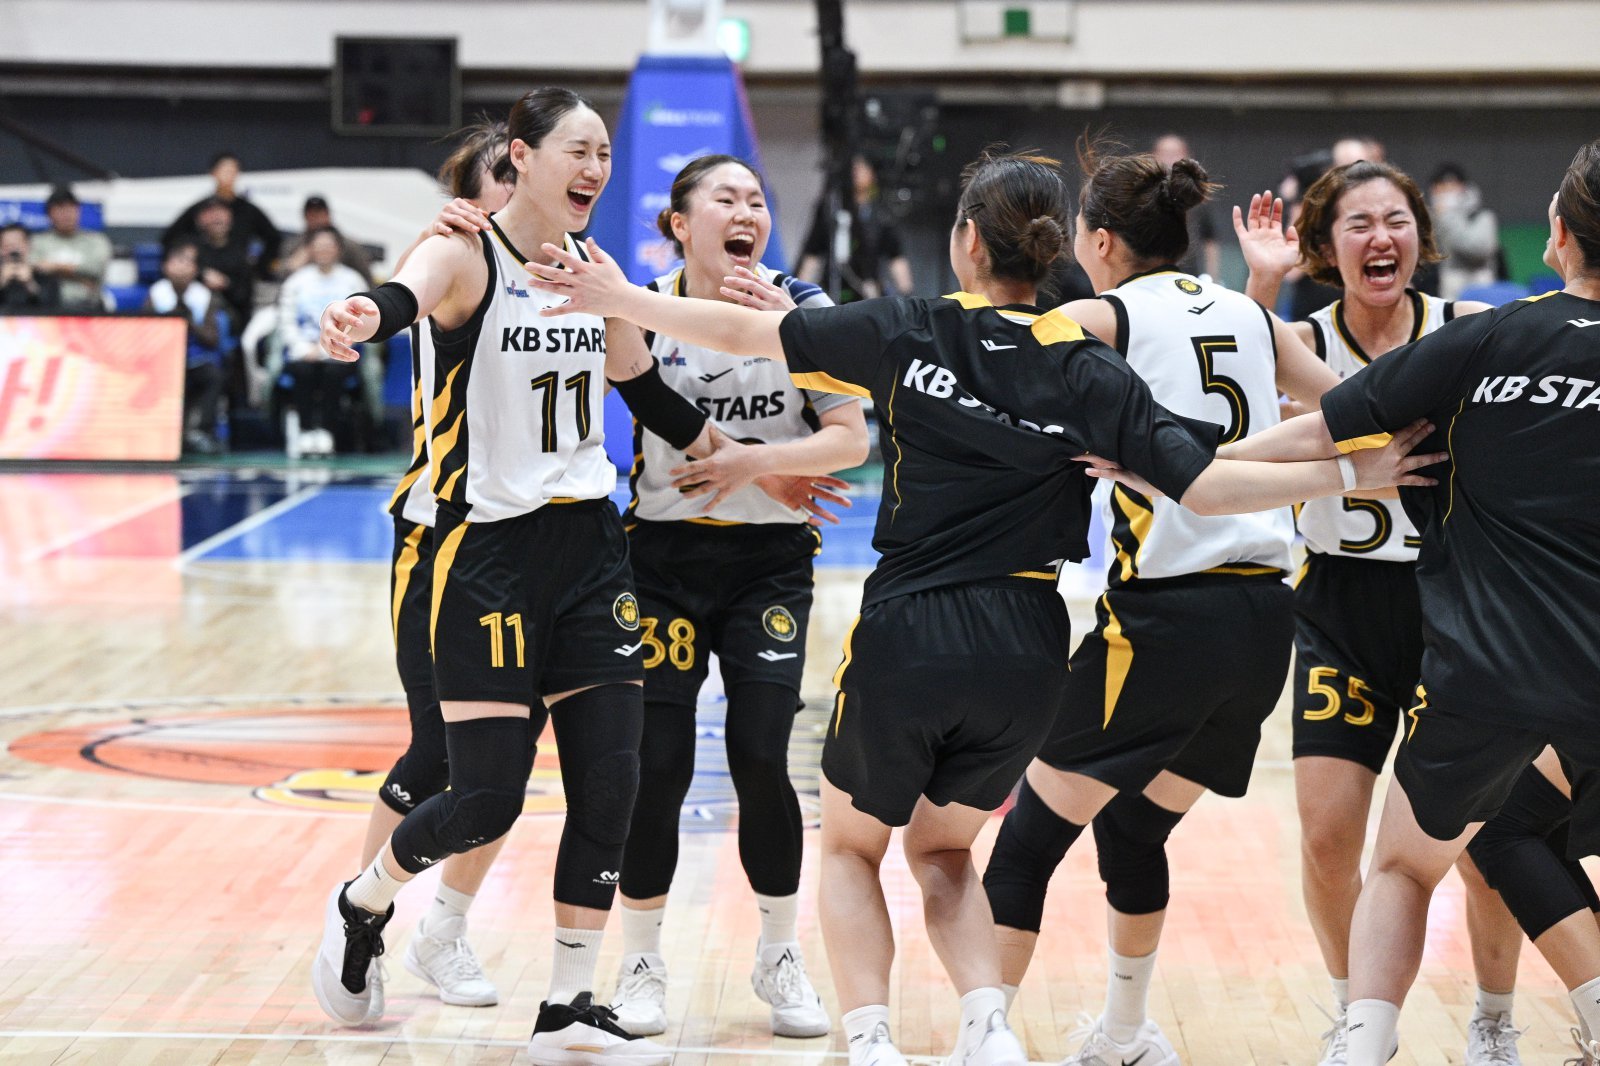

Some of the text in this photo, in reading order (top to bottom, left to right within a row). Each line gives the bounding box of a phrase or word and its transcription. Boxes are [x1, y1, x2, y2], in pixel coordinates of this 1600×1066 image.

[501, 326, 541, 353] KB
[902, 358, 958, 399] KB
[1190, 335, 1250, 448] 5
[1471, 375, 1531, 404] KB
[530, 370, 591, 453] 11
[695, 390, 785, 422] STARS
[479, 612, 525, 668] 11
[639, 617, 696, 671] 38
[1303, 666, 1375, 727] 55
